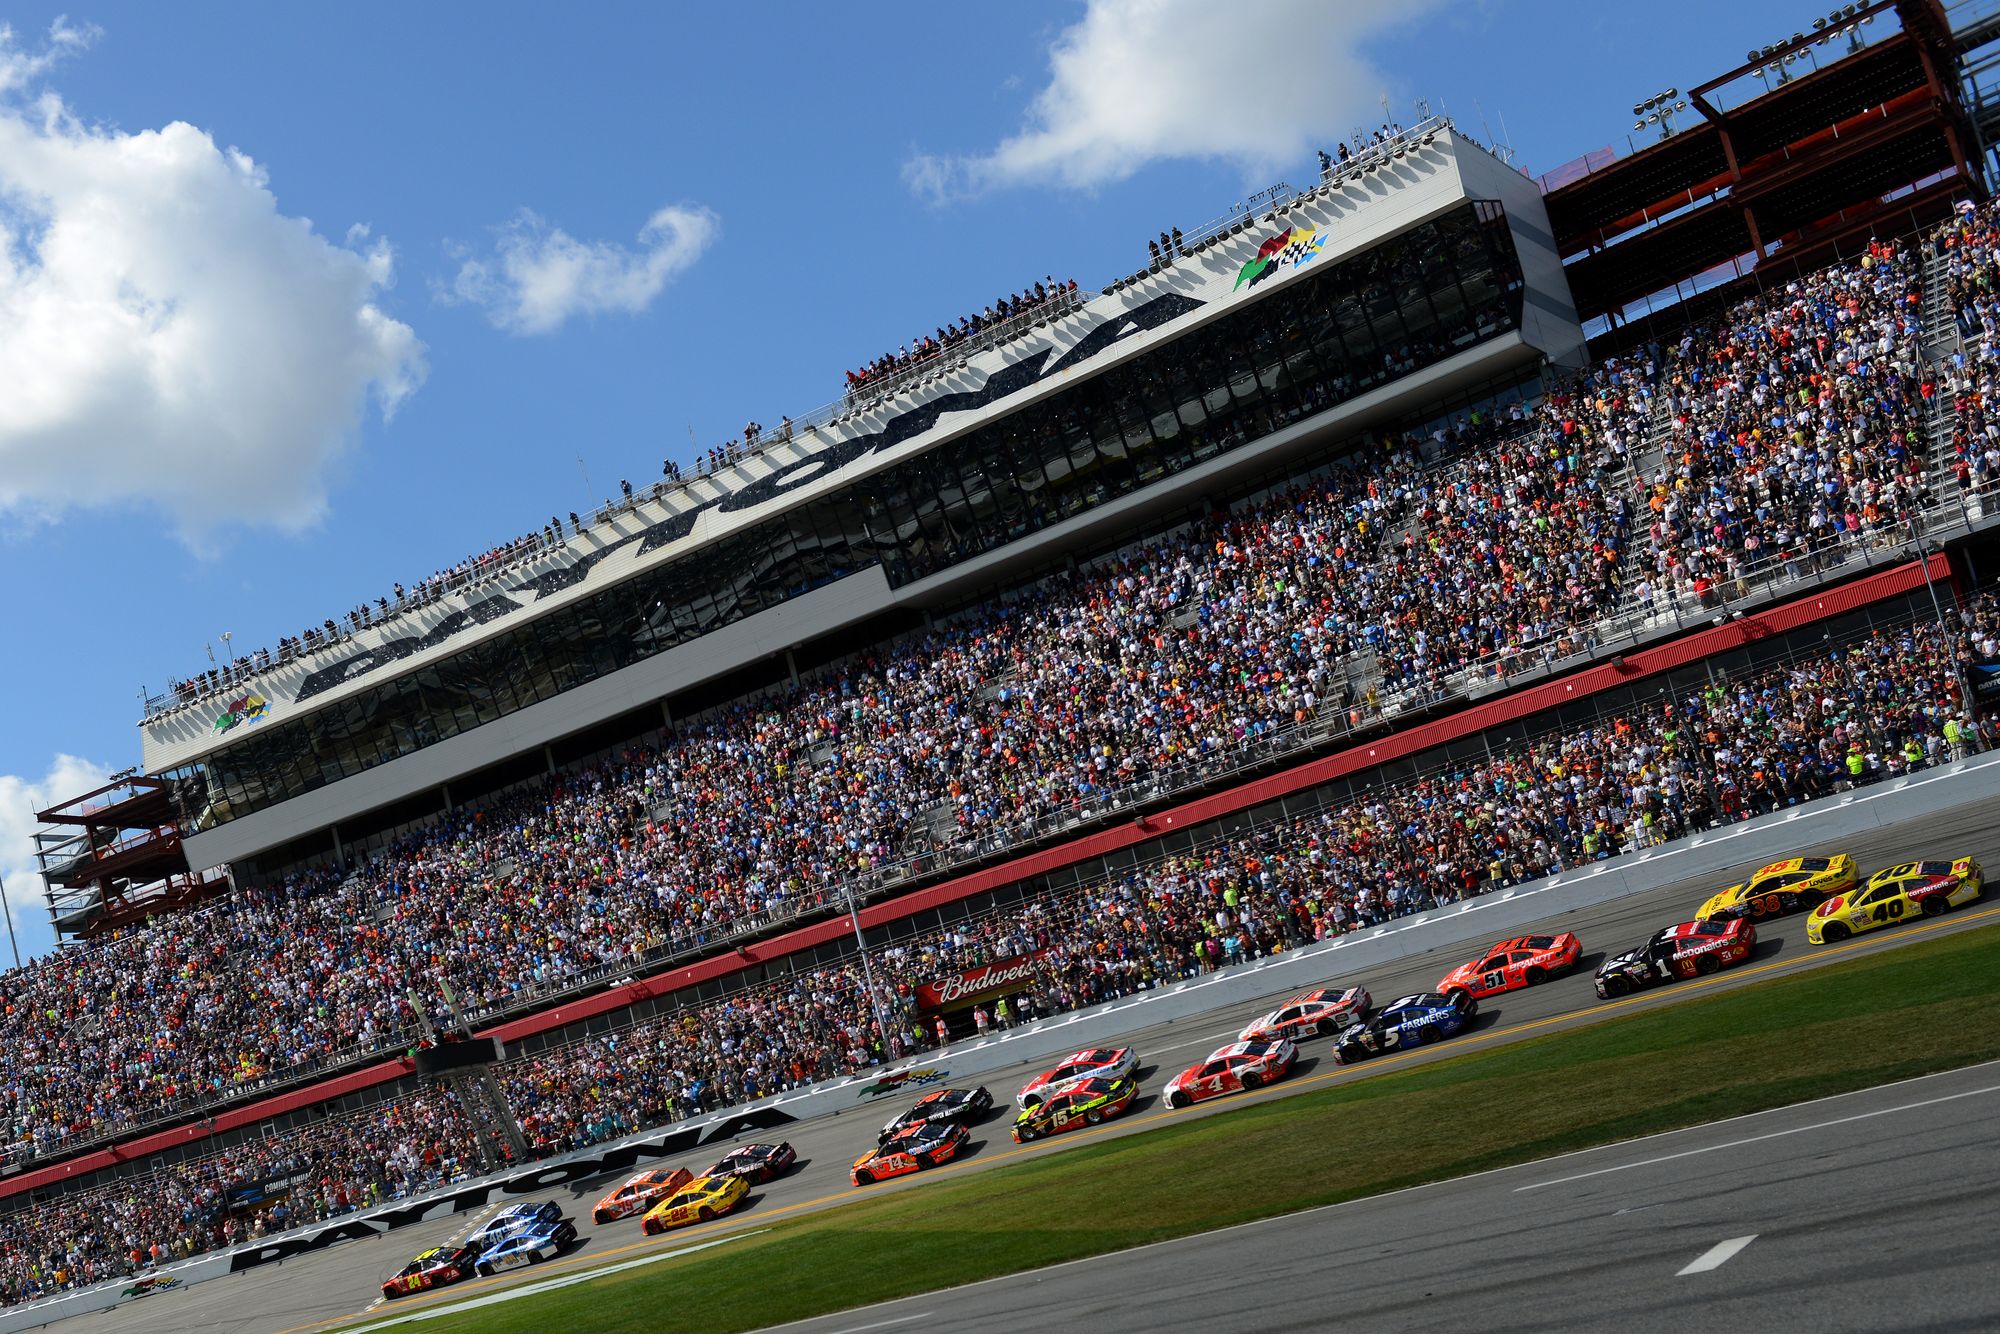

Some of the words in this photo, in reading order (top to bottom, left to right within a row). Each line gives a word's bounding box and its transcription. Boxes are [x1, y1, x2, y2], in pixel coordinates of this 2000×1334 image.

[294, 292, 1207, 704] DAYTONA
[1751, 895, 1780, 917] 38
[1872, 899, 1904, 922] 40
[1661, 925, 1679, 940] 1
[1672, 938, 1729, 961] McDonald's
[1508, 951, 1554, 972] BRANDT
[1656, 959, 1671, 978] 1
[1485, 970, 1506, 989] 51
[1280, 1022, 1298, 1038] 44
[1401, 1010, 1450, 1031] FARMERS
[1384, 1026, 1399, 1047] 5
[1208, 1075, 1224, 1092] 4
[1050, 1110, 1068, 1128] 15
[887, 1155, 905, 1172] 14
[229, 1107, 799, 1273] DAYTONA
[620, 1201, 635, 1213] 19
[670, 1206, 689, 1220] 22
[488, 1229, 504, 1245] 48
[407, 1274, 421, 1289] 24
